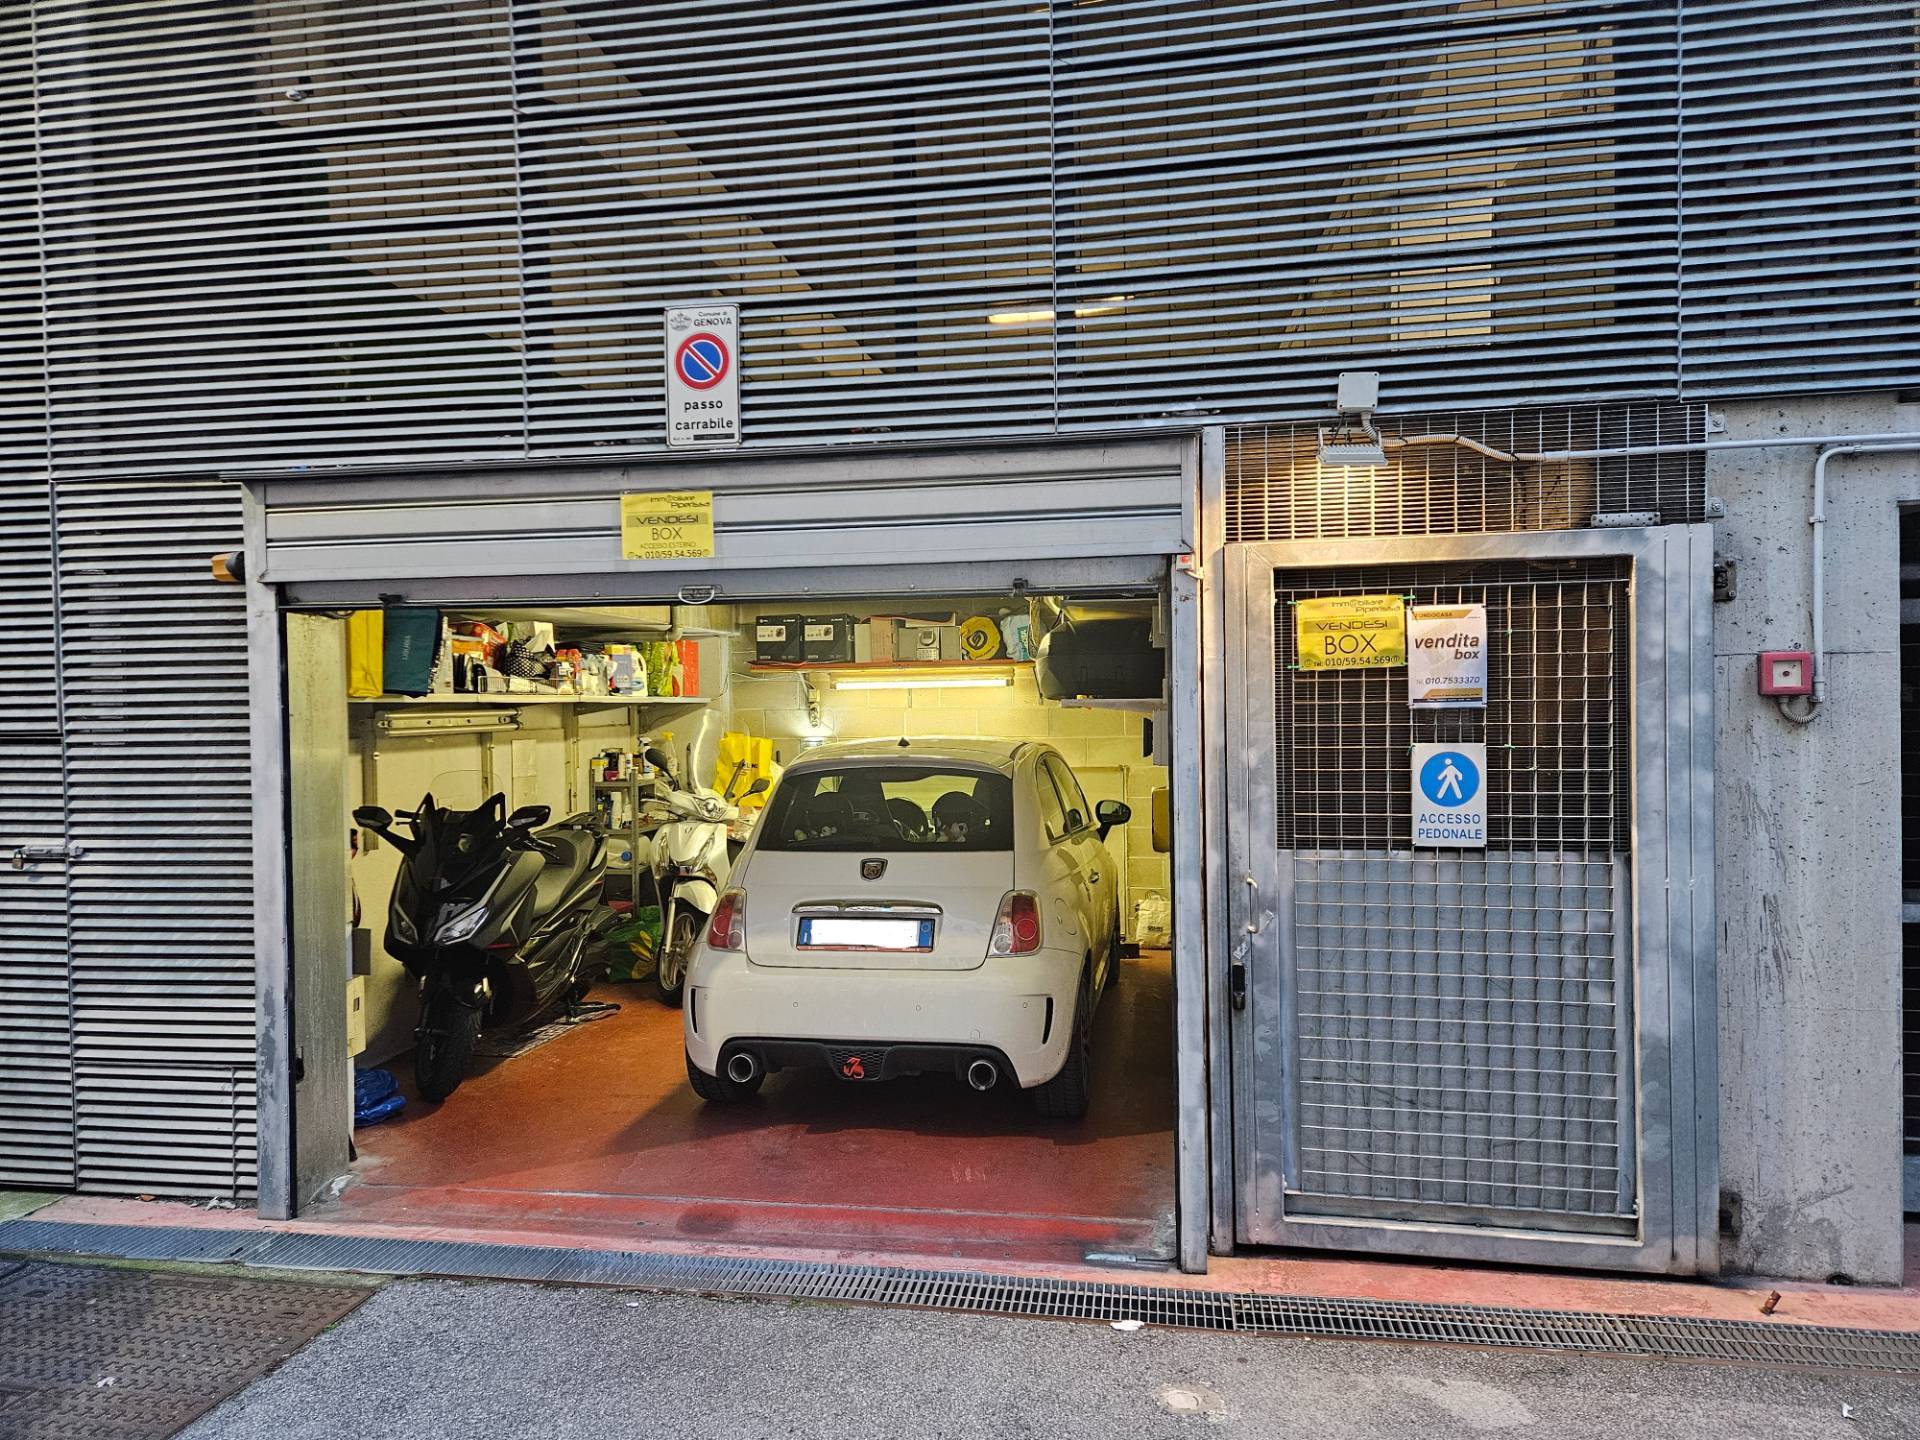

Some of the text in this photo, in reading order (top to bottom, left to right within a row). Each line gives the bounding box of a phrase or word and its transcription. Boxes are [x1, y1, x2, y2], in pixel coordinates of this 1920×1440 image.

[693, 317, 732, 327] GENOVA
[684, 399, 723, 413] passo
[675, 417, 734, 431] carrabile
[636, 514, 699, 525] VENDESI
[651, 527, 683, 541] BOX
[1316, 620, 1388, 631] VENDESI
[1324, 633, 1377, 655] BOX
[1414, 633, 1480, 650] vendita
[1454, 649, 1480, 660] box
[1325, 656, 1391, 667] 010/59.54.569
[1425, 676, 1480, 685] 010.7533370
[1419, 813, 1481, 824] ACCESSO
[1418, 827, 1483, 840] PEDONALE
